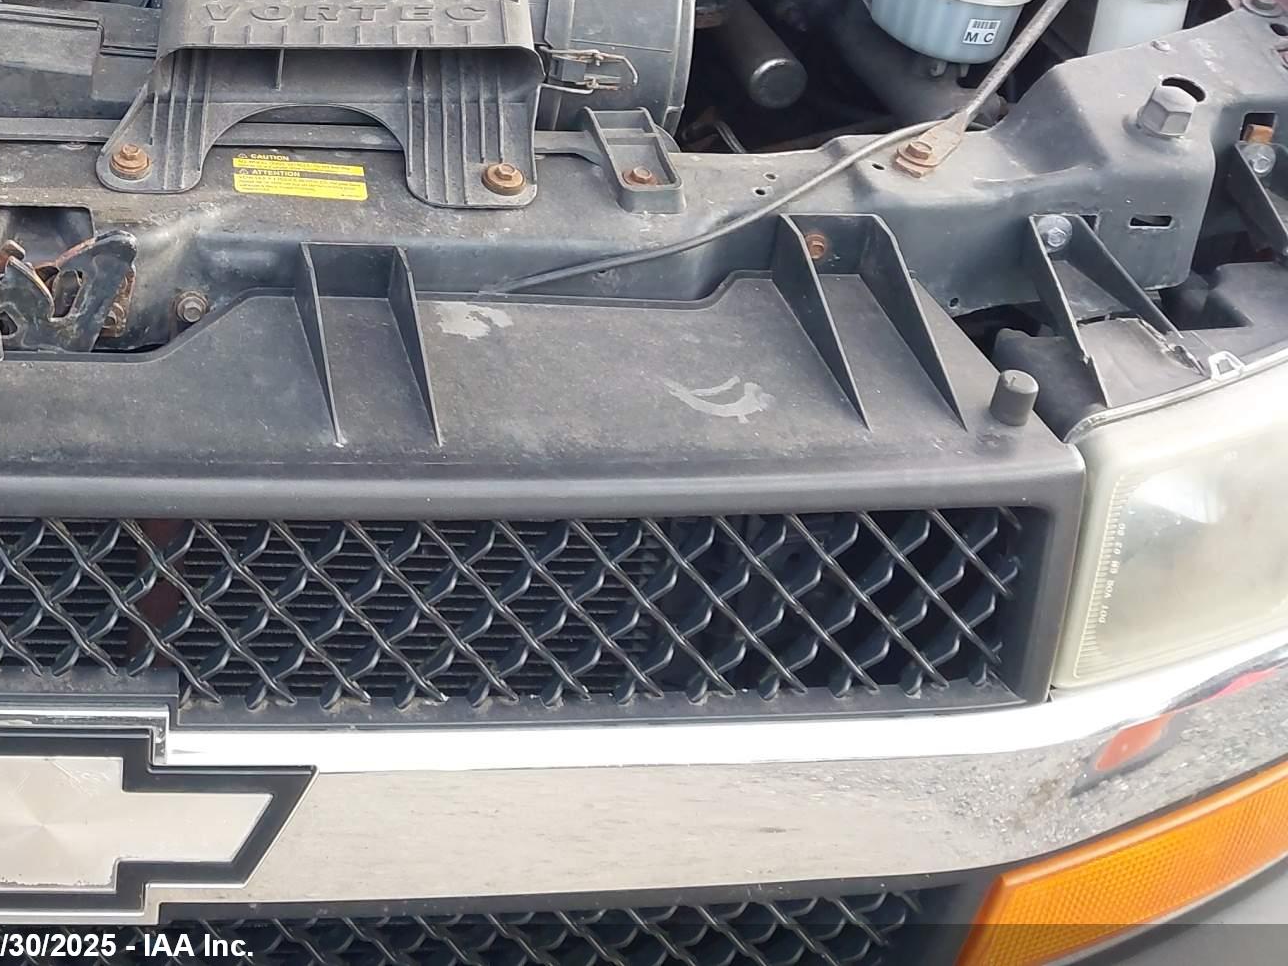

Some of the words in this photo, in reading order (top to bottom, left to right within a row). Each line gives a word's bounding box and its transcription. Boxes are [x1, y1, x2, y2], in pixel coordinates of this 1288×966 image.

[205, 3, 488, 21] VORTEC
[250, 153, 290, 161] CAUTION
[252, 169, 301, 177] ATTENTION
